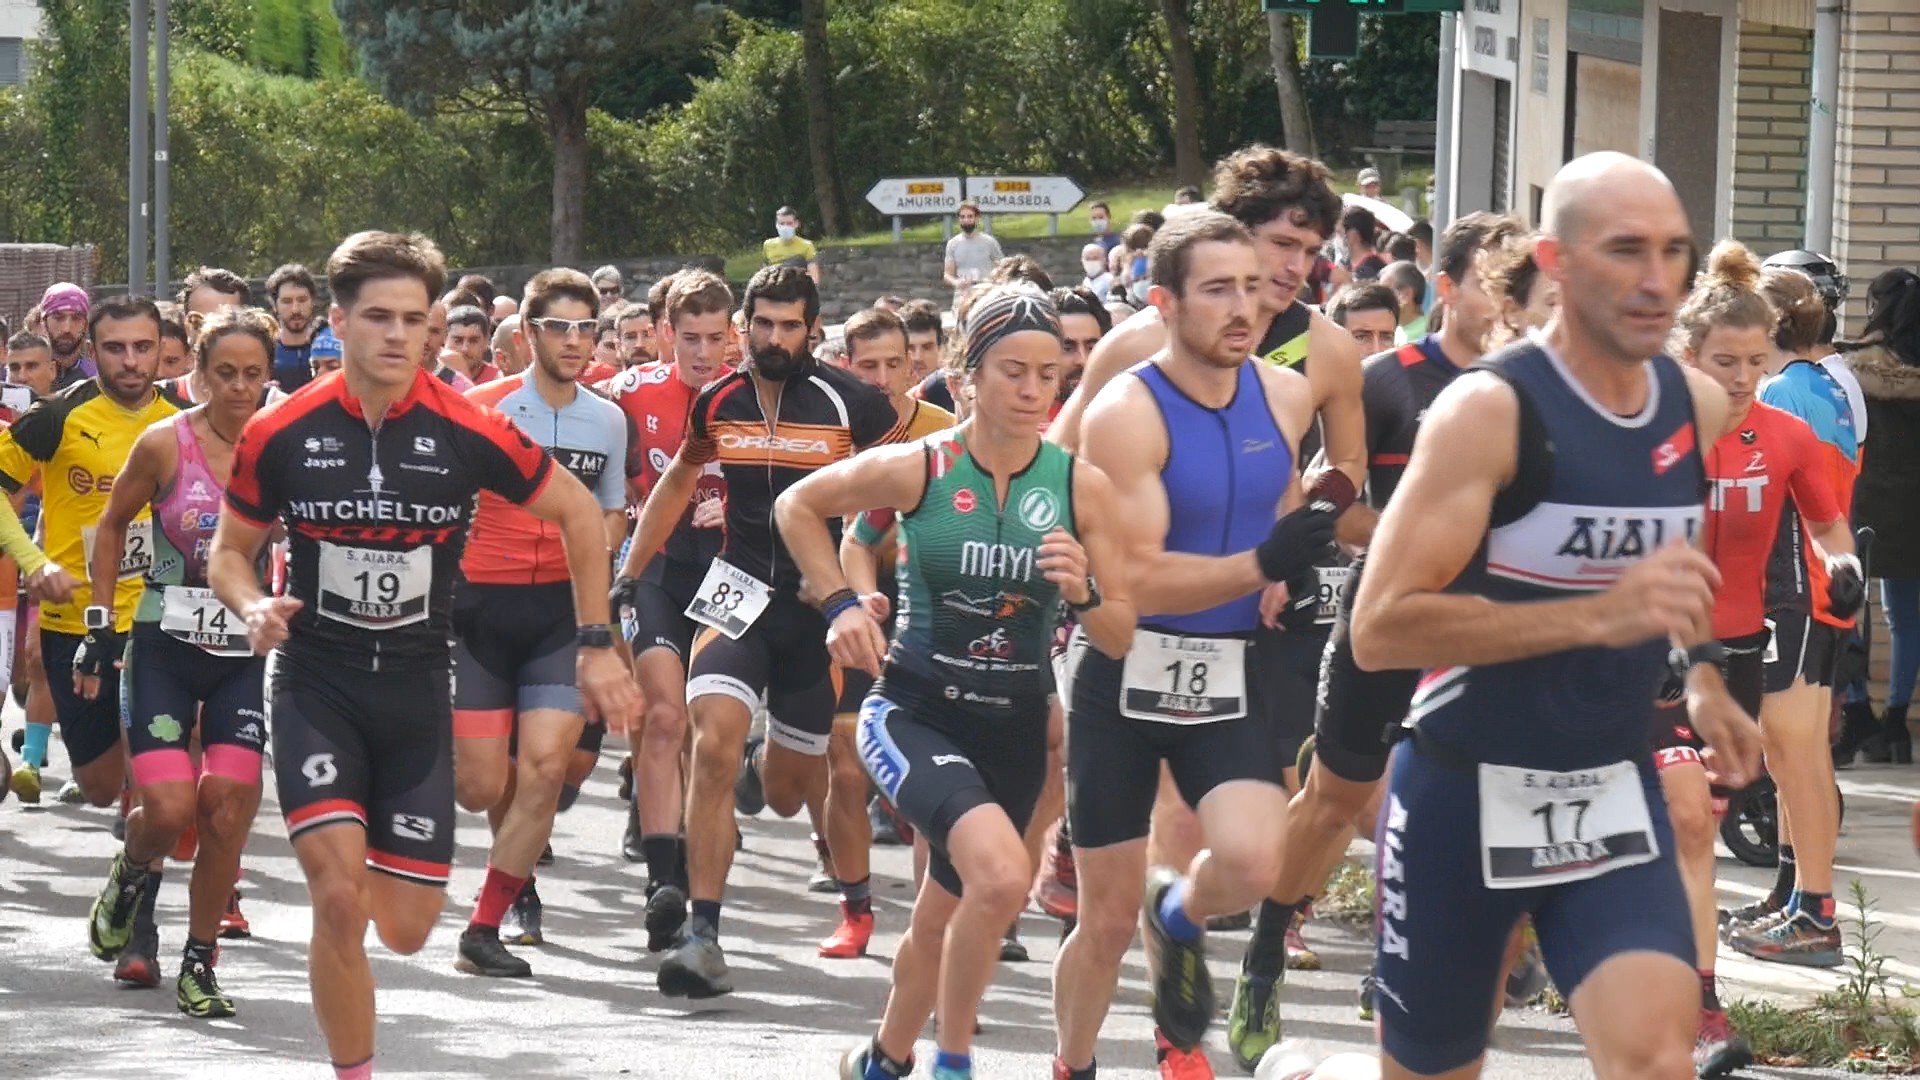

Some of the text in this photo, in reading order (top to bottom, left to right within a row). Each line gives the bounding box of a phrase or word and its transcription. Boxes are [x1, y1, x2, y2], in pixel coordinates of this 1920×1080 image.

[896, 196, 955, 208] AMURRIO
[719, 433, 831, 455] ORBEA
[303, 457, 346, 469] Jayco
[567, 452, 605, 471] ZMT
[289, 500, 462, 524] MITCHELTON
[353, 570, 401, 603] 19
[711, 581, 744, 611] 83
[192, 606, 228, 633] 14
[350, 602, 402, 618] AIARA
[188, 631, 229, 647] AIARA
[1165, 660, 1208, 695] 18
[1531, 799, 1591, 844] 17
